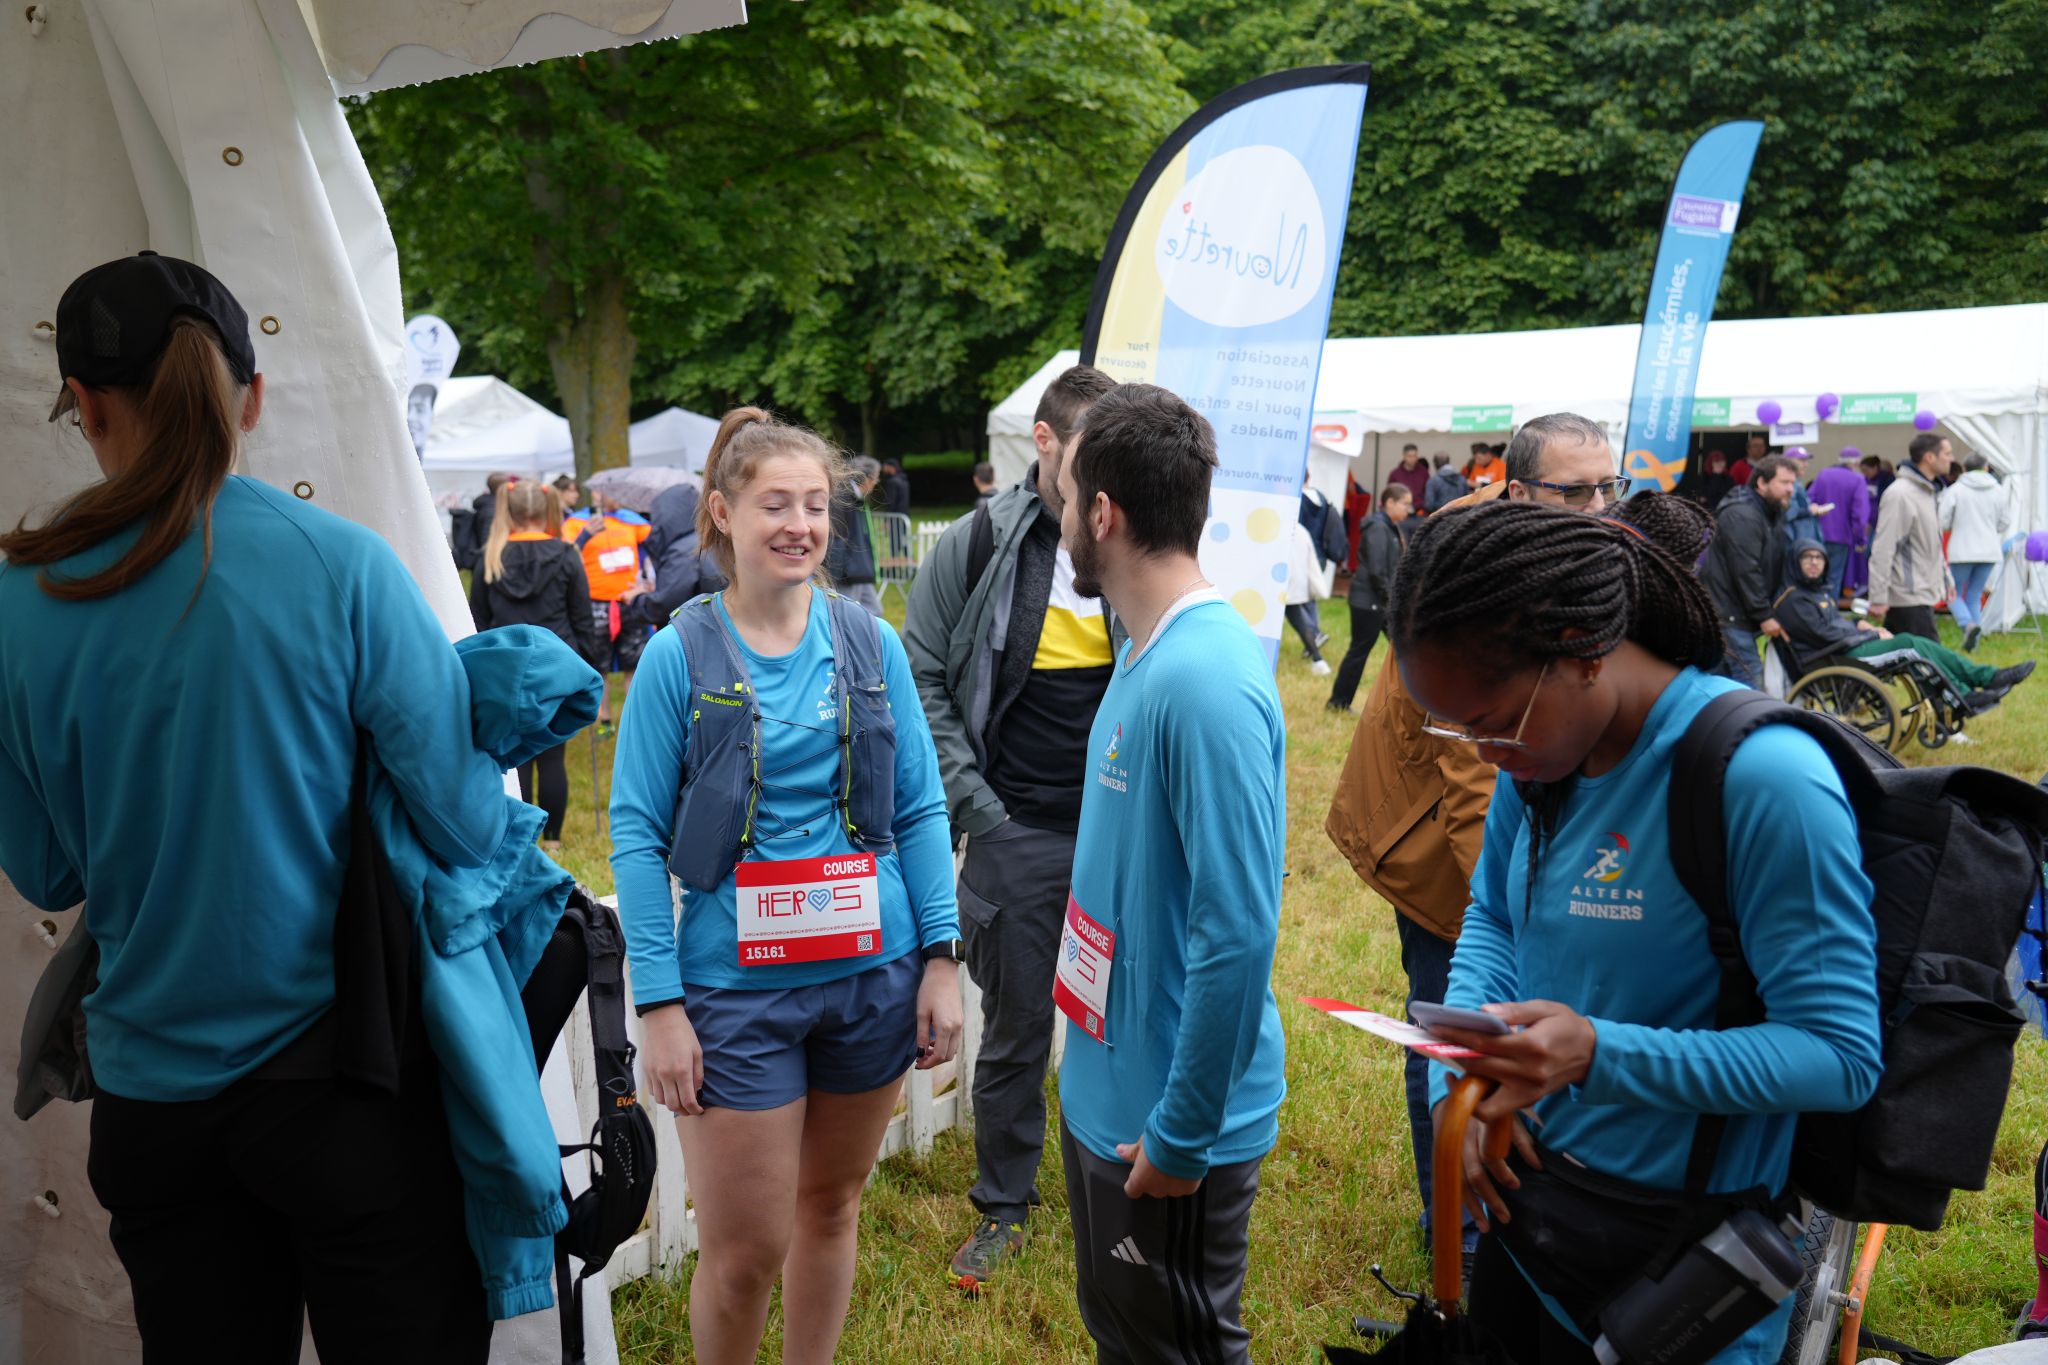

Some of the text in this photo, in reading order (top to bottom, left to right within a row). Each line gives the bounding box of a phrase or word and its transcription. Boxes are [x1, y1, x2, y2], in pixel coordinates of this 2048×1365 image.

[1650, 258, 1694, 368] leucémies,
[1678, 311, 1700, 342] vie
[1672, 345, 1693, 366] la
[1642, 391, 1663, 441] Contre
[700, 692, 744, 708] SALOMON
[823, 858, 870, 877] COURSE
[1571, 885, 1644, 900] ALTEN
[1568, 900, 1644, 921] RUNNERS
[1077, 915, 1109, 953] COURSE
[745, 945, 787, 960] 15161
